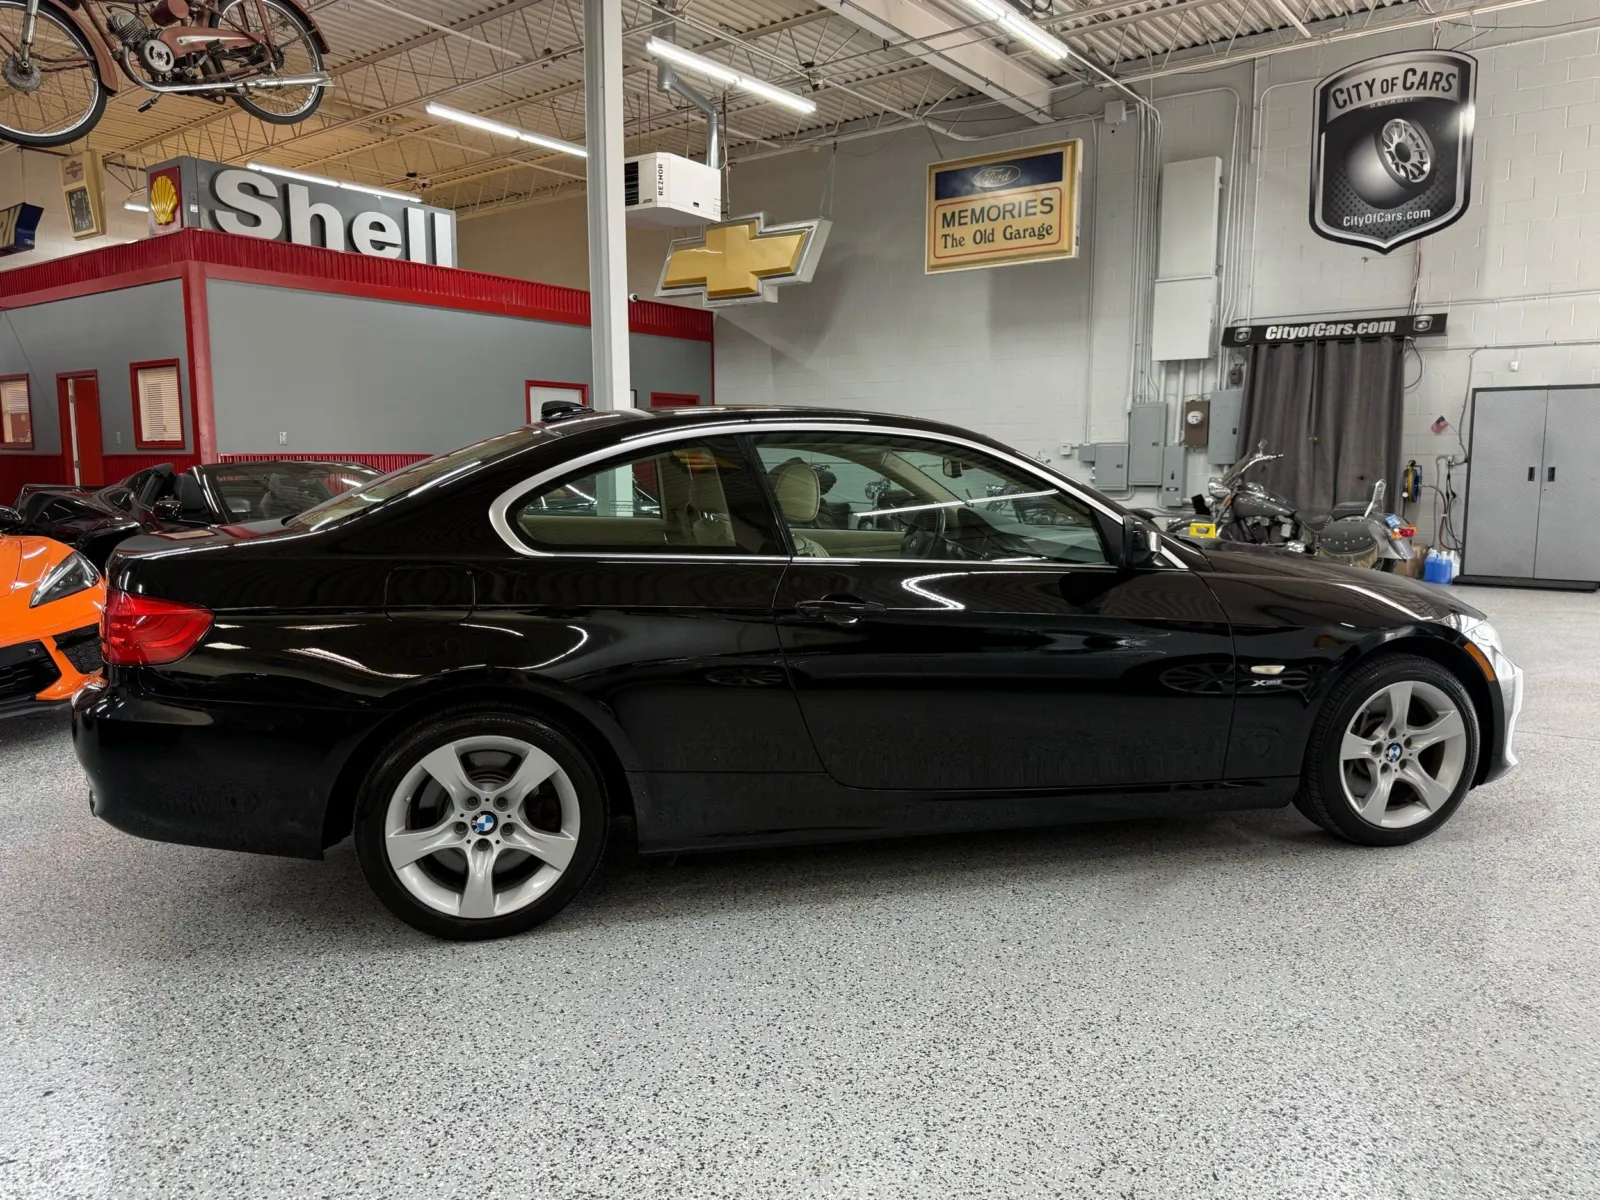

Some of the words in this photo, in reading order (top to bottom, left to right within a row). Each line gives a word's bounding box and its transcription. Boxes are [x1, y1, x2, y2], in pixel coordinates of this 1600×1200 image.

[1331, 77, 1377, 110] CITY
[1380, 76, 1400, 95] OF
[1402, 67, 1457, 93] CARS
[1370, 97, 1415, 108] DETROIT
[984, 168, 1011, 185] Ford
[214, 169, 453, 268] Shell
[941, 197, 1054, 229] MEMORIES
[1343, 208, 1431, 227] CityOfCars.com
[941, 233, 966, 249] The
[973, 228, 995, 245] Old
[1003, 222, 1054, 241] Garage
[1264, 320, 1396, 340] CityofCars.com
